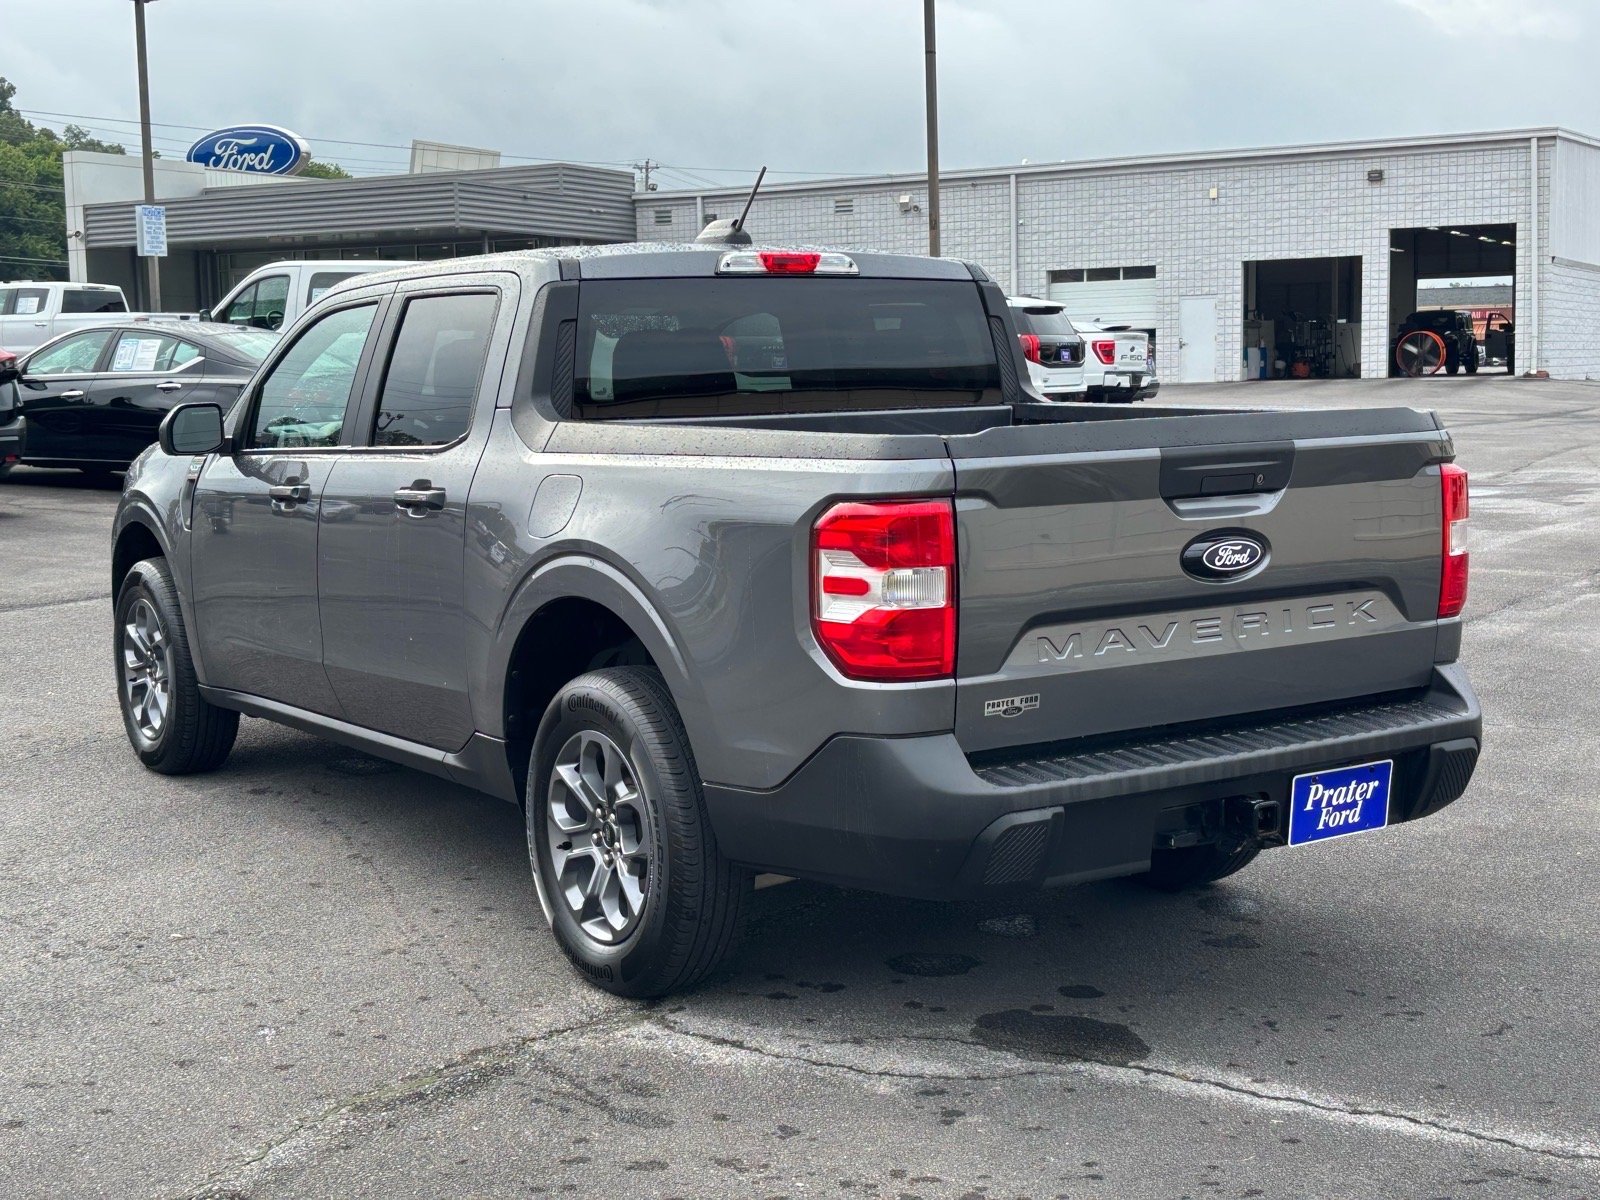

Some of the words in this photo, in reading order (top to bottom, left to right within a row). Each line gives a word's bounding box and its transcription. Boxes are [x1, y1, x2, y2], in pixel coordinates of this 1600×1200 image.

[209, 138, 275, 171] Ford
[1215, 545, 1250, 566] Ford
[1036, 598, 1379, 663] MAVERICK
[986, 699, 1015, 709] PRATER
[1020, 696, 1038, 704] FORD
[1303, 780, 1379, 811] Prater
[1316, 800, 1363, 830] Ford
